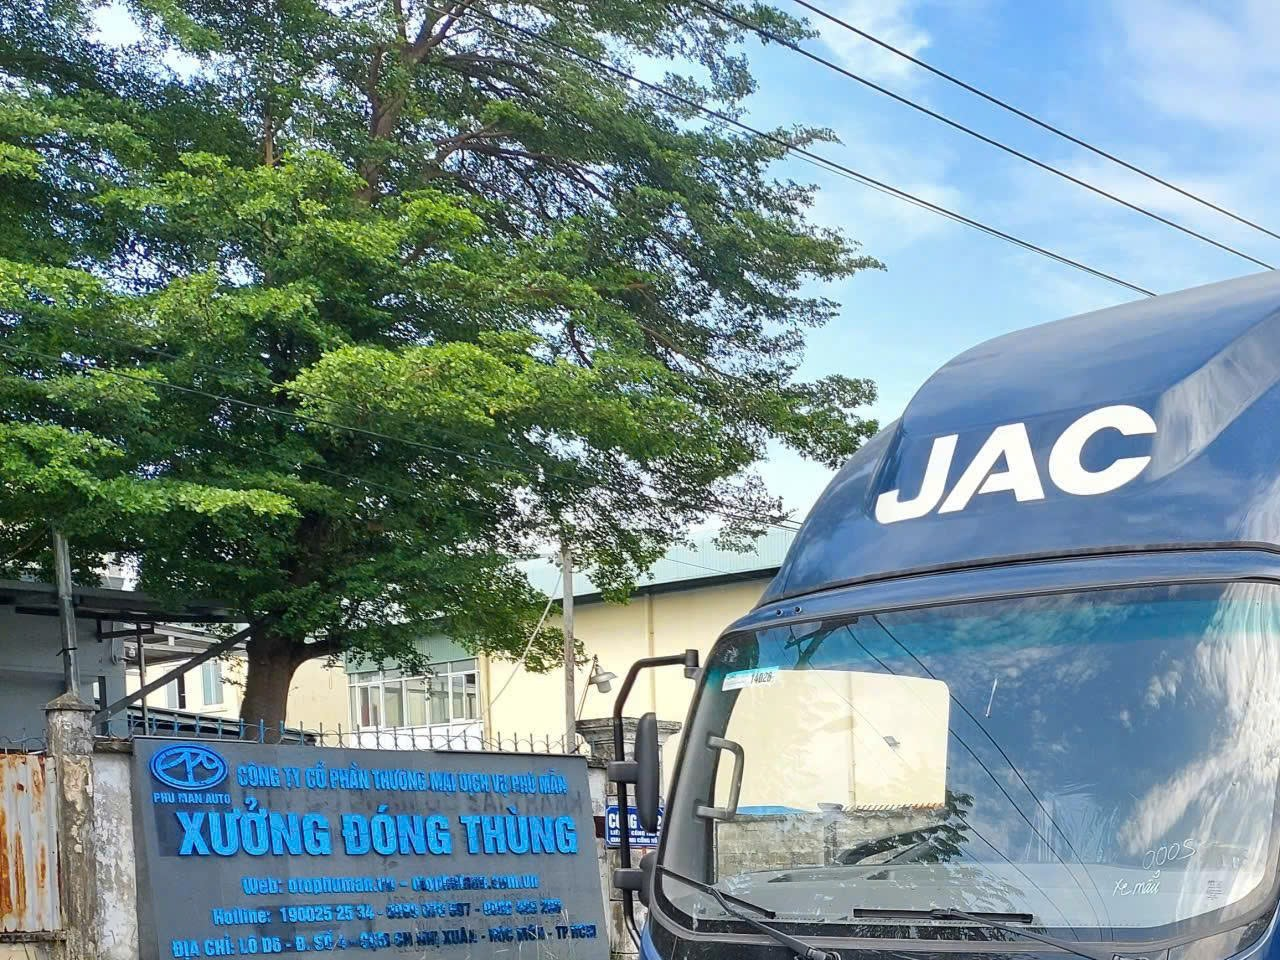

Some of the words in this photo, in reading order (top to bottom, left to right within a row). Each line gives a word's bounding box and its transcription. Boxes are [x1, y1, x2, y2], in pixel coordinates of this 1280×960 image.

[875, 404, 1157, 524] JAC
[238, 761, 280, 788] CÔNG
[282, 767, 301, 789] TY
[329, 761, 371, 790] PHẦN
[153, 792, 175, 803] PHU
[177, 792, 202, 804] MAN
[205, 793, 231, 805] AUTO
[175, 797, 332, 856] XƯỞNG
[341, 804, 452, 856] ĐÓNG
[458, 804, 578, 856] THÙNG
[241, 876, 283, 895] Web:
[212, 907, 272, 926] Hotline:
[279, 906, 333, 923] 190025
[336, 905, 353, 921] 25
[356, 904, 375, 920] 34
[172, 938, 200, 960] ĐỊA
[239, 936, 258, 954] LÔ
